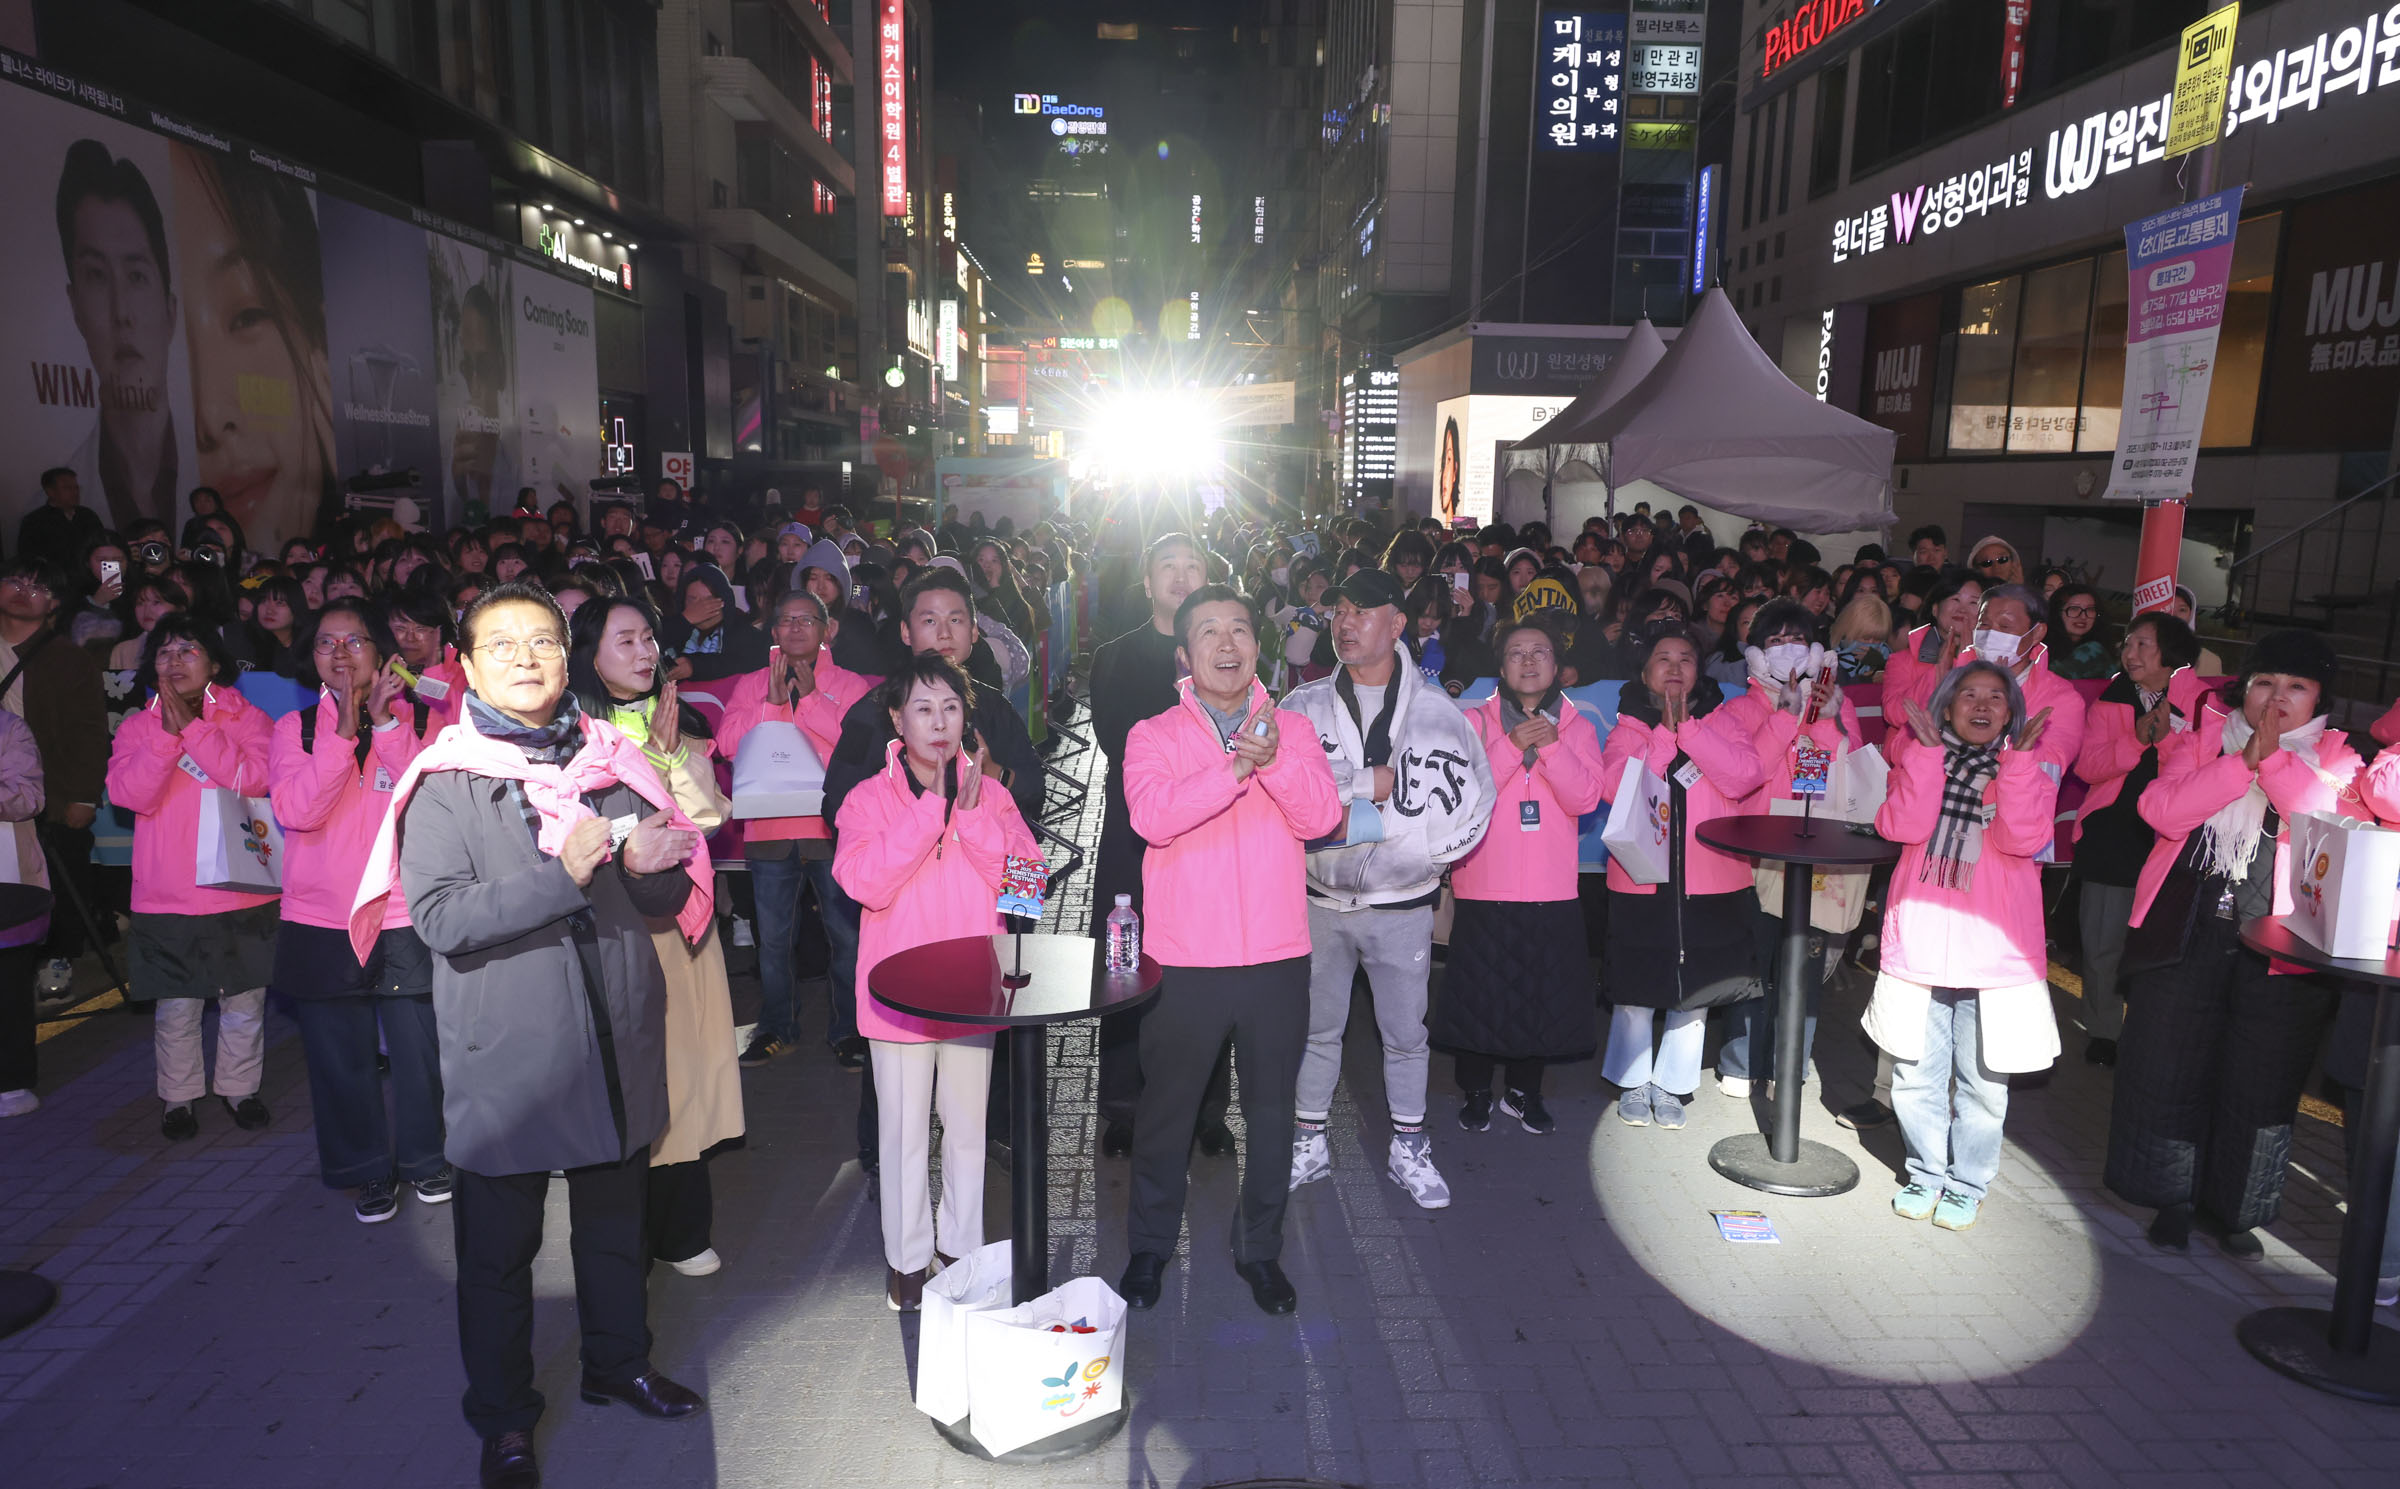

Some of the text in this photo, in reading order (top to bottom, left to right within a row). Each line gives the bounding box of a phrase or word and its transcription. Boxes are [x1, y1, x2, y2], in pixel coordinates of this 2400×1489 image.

[1636, 19, 1700, 33] 필러보톡스
[35, 66, 75, 96] 라이프가
[1548, 16, 1582, 146] 미케이의원
[1632, 71, 1697, 89] 반영구화장
[1600, 50, 1621, 139] 성형외과
[1042, 104, 1103, 117] DaeDong
[552, 231, 567, 264] AI
[2156, 266, 2187, 287] 통제구간
[2189, 284, 2222, 304] 일부구간
[523, 296, 589, 337] Coming Soon
[2187, 303, 2220, 323] 일부구간
[2308, 334, 2400, 373] 無印良品
[1875, 344, 1921, 392] MUJI
[31, 360, 95, 408] WIM
[344, 402, 431, 426] WellnessHouseStore
[2134, 580, 2169, 607] STREET
[1006, 868, 1045, 880] CHEMISTREET
[1011, 874, 1038, 884] FESTIVAL
